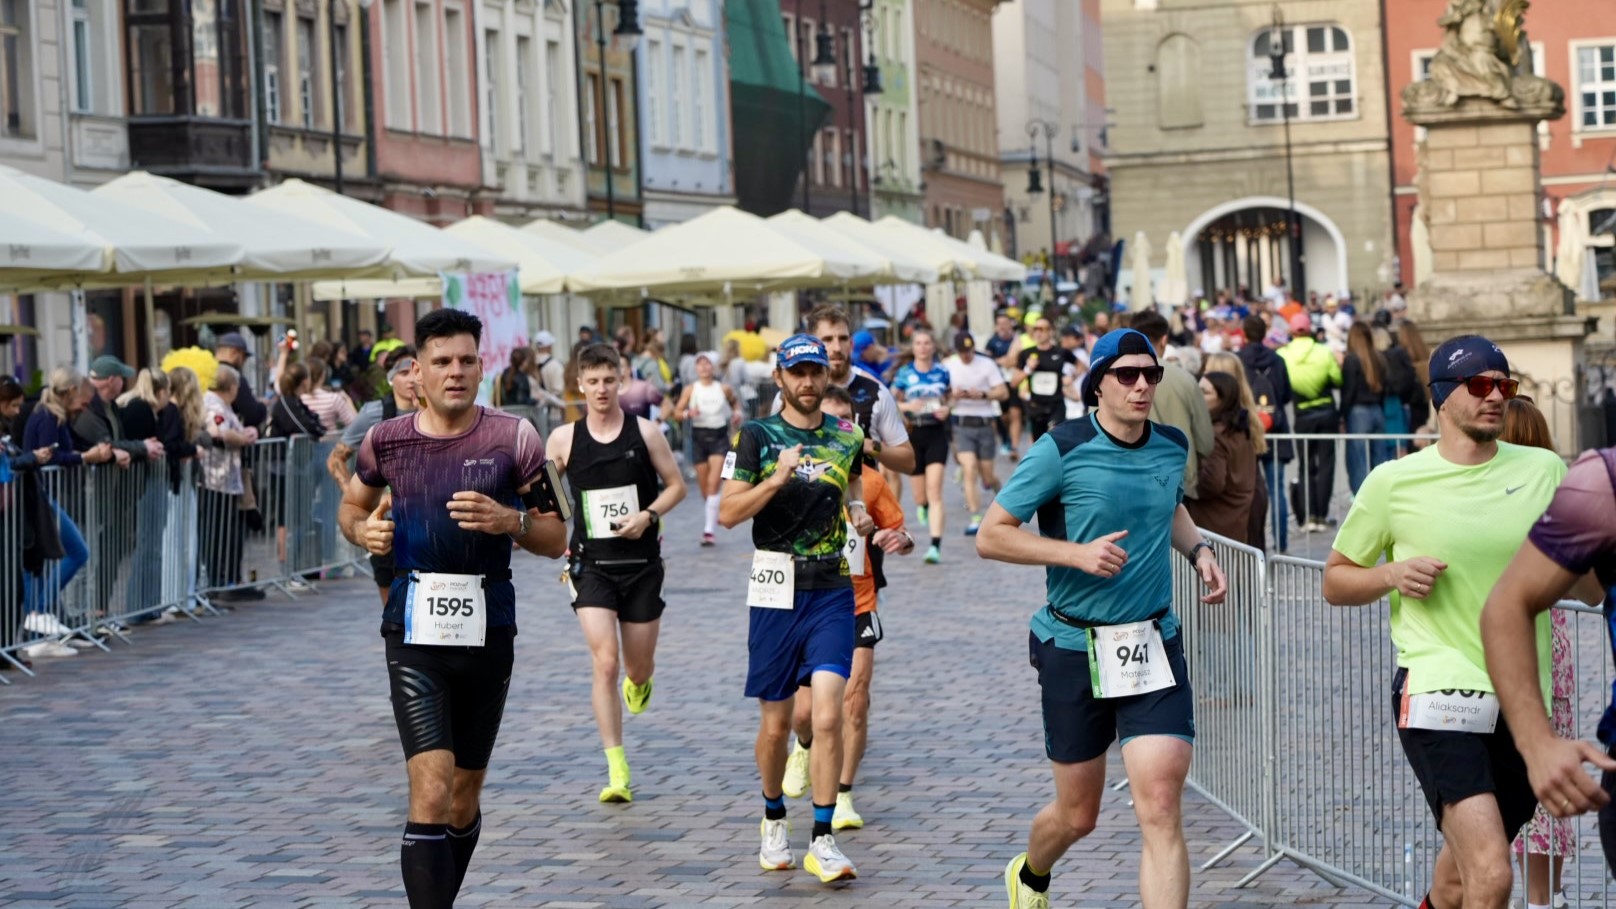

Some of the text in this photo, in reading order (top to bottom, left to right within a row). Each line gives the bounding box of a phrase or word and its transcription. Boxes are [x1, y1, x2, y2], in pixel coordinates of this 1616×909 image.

[790, 345, 819, 356] HOKA
[600, 502, 629, 518] 756
[750, 568, 785, 584] 4670
[426, 596, 474, 617] 1595
[434, 621, 464, 630] Hubert
[1116, 643, 1149, 667] 941
[1120, 670, 1152, 679] Mateusz
[1428, 701, 1481, 714] Aliaksandr
